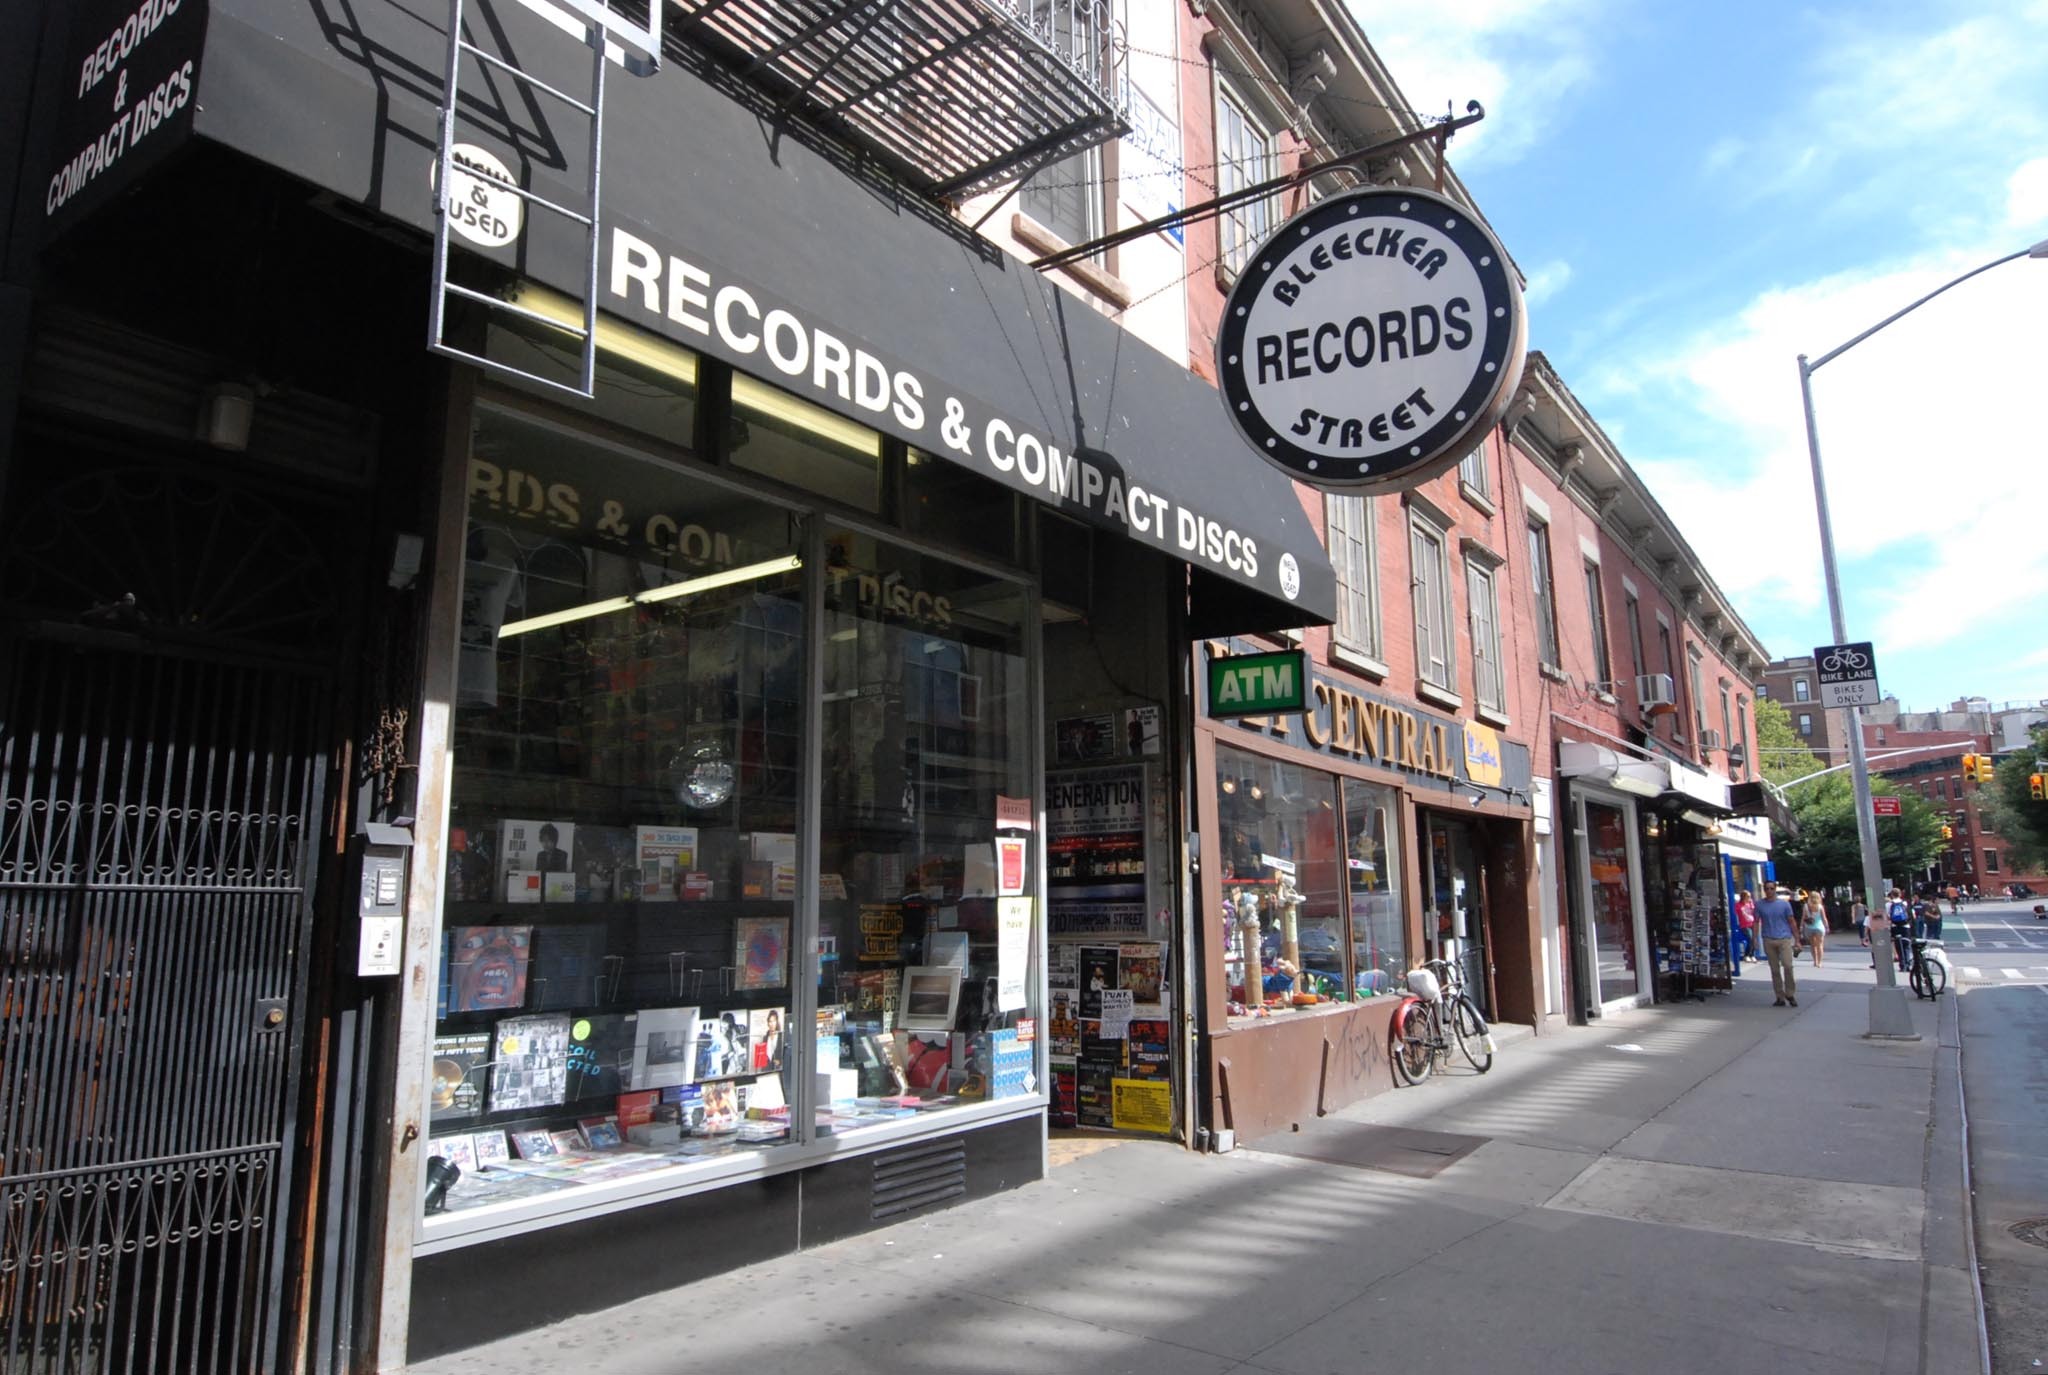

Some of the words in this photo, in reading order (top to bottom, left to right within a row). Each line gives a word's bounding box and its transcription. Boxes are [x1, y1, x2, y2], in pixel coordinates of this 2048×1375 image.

[114, 69, 128, 112] &
[47, 112, 131, 216] COMPACT
[131, 60, 193, 147] DISCS
[449, 198, 508, 239] USED
[470, 185, 488, 209] &
[1273, 227, 1448, 307] BLEECKER
[1257, 297, 1473, 384] RECORDS
[611, 227, 924, 430] RECORDS
[941, 397, 973, 455] &
[985, 418, 1169, 539] COMPACT
[1178, 509, 1258, 578] DISCS
[1290, 387, 1436, 448] STREET
[1218, 664, 1293, 704] ATM
[1821, 673, 1844, 682] BIKE
[1848, 669, 1874, 680] LANE
[1834, 685, 1865, 694] BIKES
[1837, 695, 1864, 704] ONLY
[1303, 679, 1455, 778] CENTRAL
